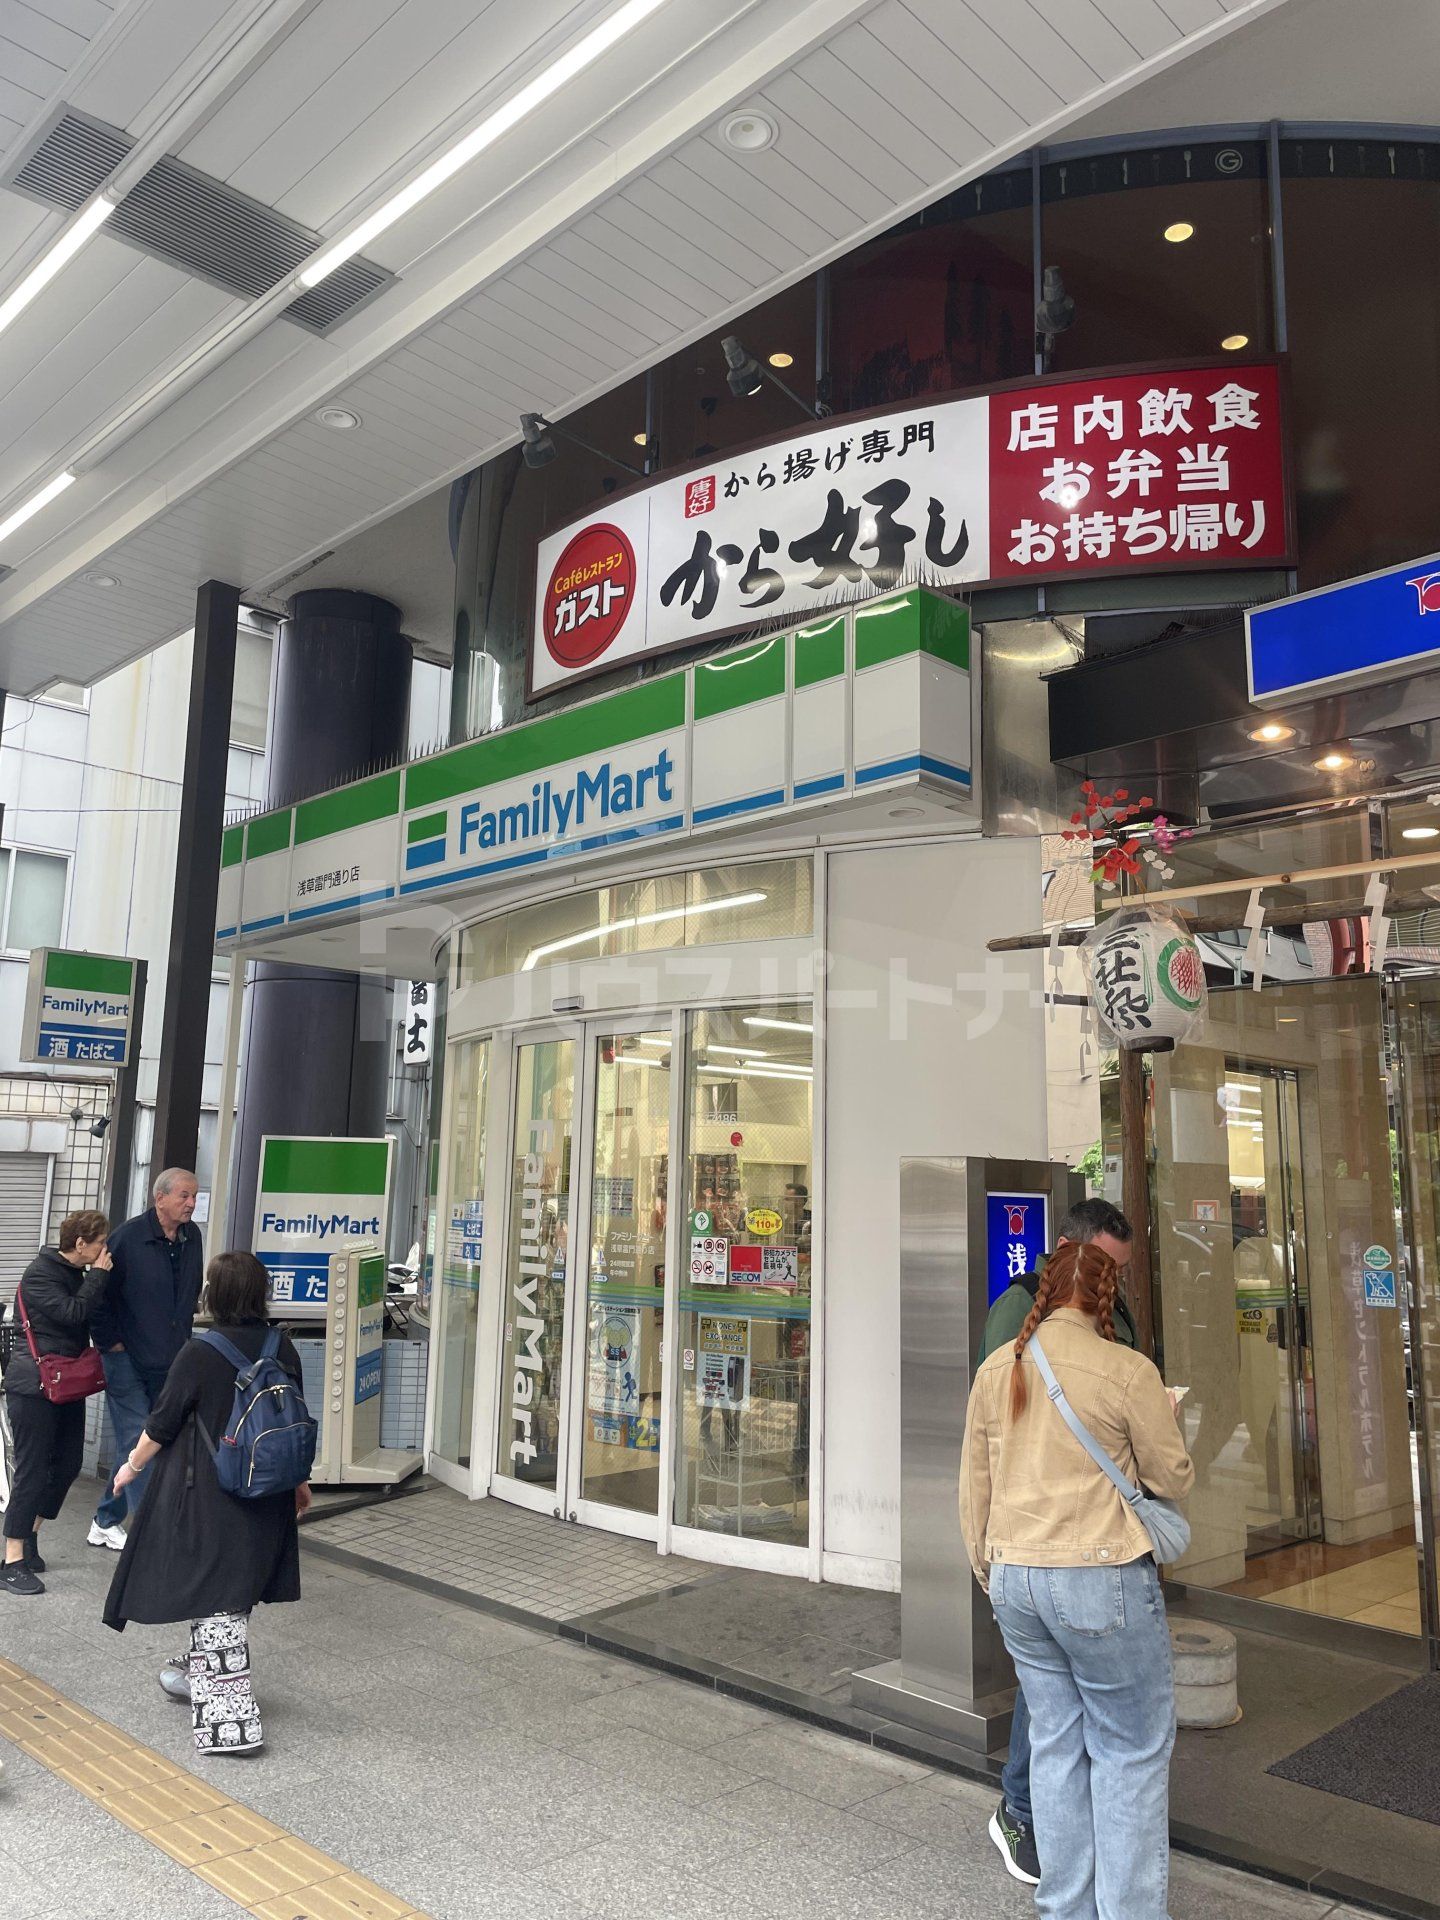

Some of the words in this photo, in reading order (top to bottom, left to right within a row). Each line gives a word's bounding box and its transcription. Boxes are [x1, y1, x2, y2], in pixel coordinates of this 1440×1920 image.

[1007, 383, 1261, 452] 店内飲食
[724, 421, 935, 498] から揚げ専門
[1039, 444, 1230, 503] お弁当
[688, 480, 711, 517] 唐好
[660, 478, 969, 620] から好し
[1007, 500, 1265, 565] お持ち帰り
[554, 579, 625, 637] ガスト
[459, 749, 673, 854] FamilyMart
[297, 865, 360, 896] 浅草雷門通り店
[42, 995, 128, 1016] FamilyMart
[1095, 927, 1151, 1031] 三社祭
[48, 1037, 70, 1059] 酒
[75, 1042, 115, 1060] たばこ
[262, 1213, 379, 1239] FamilyMart
[731, 1272, 761, 1283] SECOM
[1007, 1243, 1027, 1277] 浅
[510, 1120, 553, 1464] FamilyMart
[705, 1332, 742, 1342] EXCHANGE
